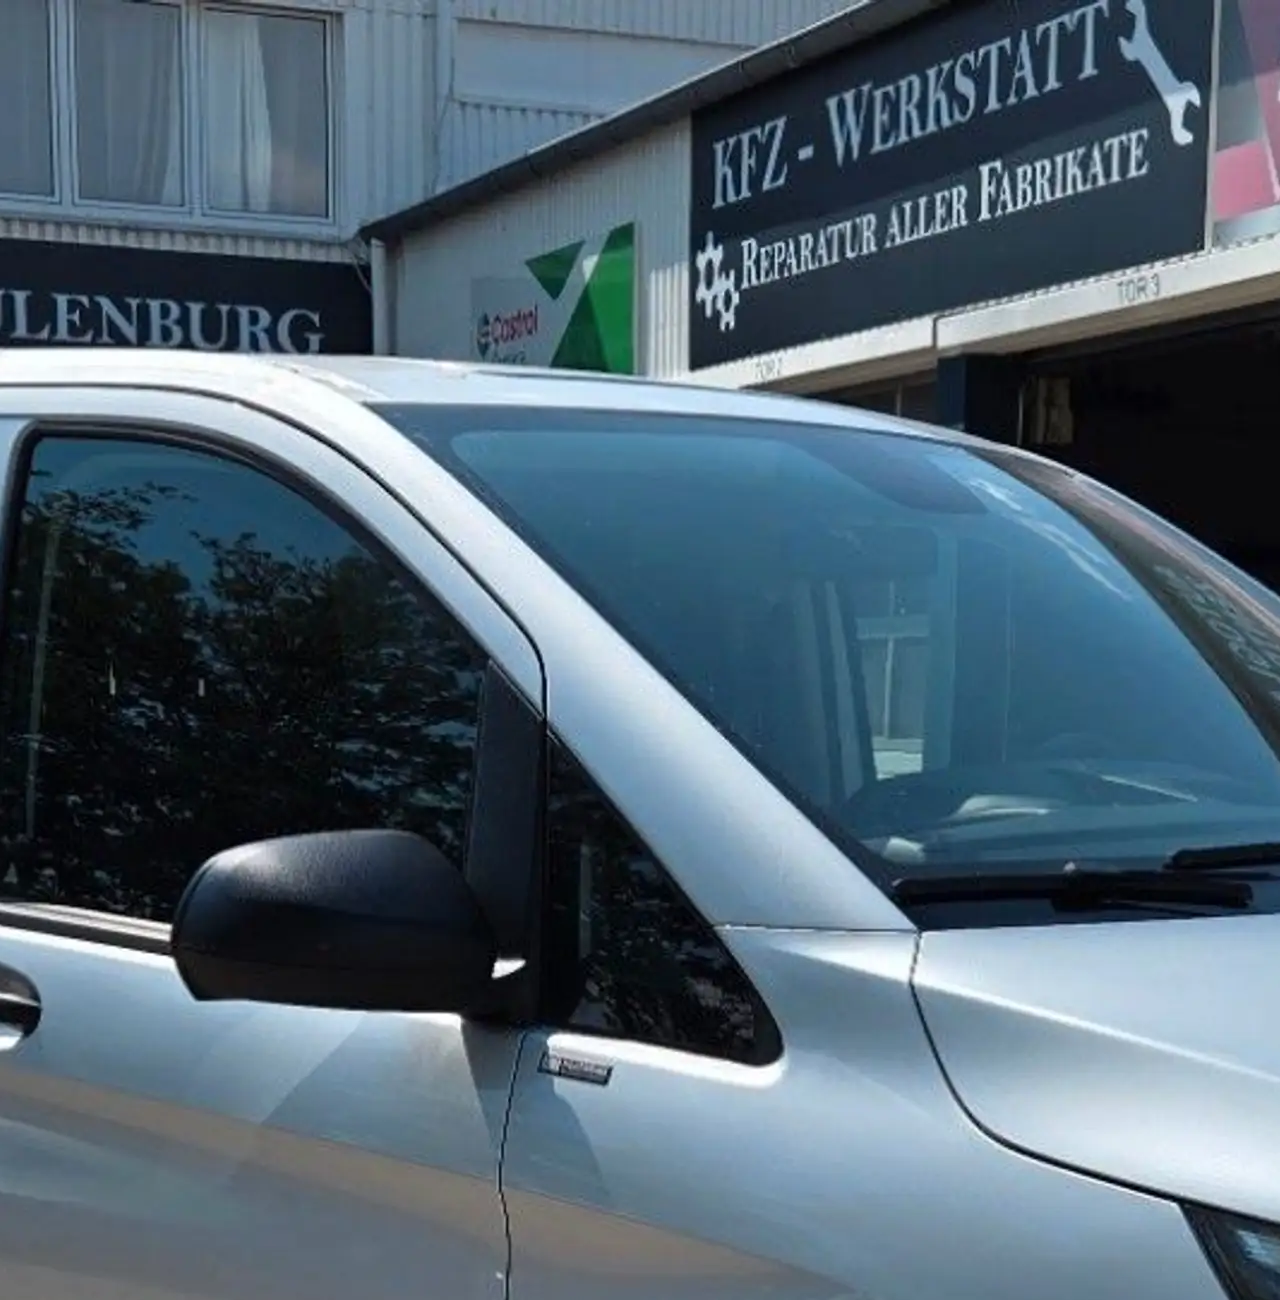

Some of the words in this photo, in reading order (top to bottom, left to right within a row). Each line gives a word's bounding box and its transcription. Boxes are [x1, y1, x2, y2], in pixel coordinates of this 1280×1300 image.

[712, 115, 787, 209] KFZ
[825, 0, 1110, 168] WERKSTATT
[740, 237, 877, 290] REPARATUR
[885, 184, 967, 249] ALLER
[978, 128, 1150, 222] FABRIKATE
[489, 303, 539, 346] Castrol
[1117, 276, 1148, 303] TOR
